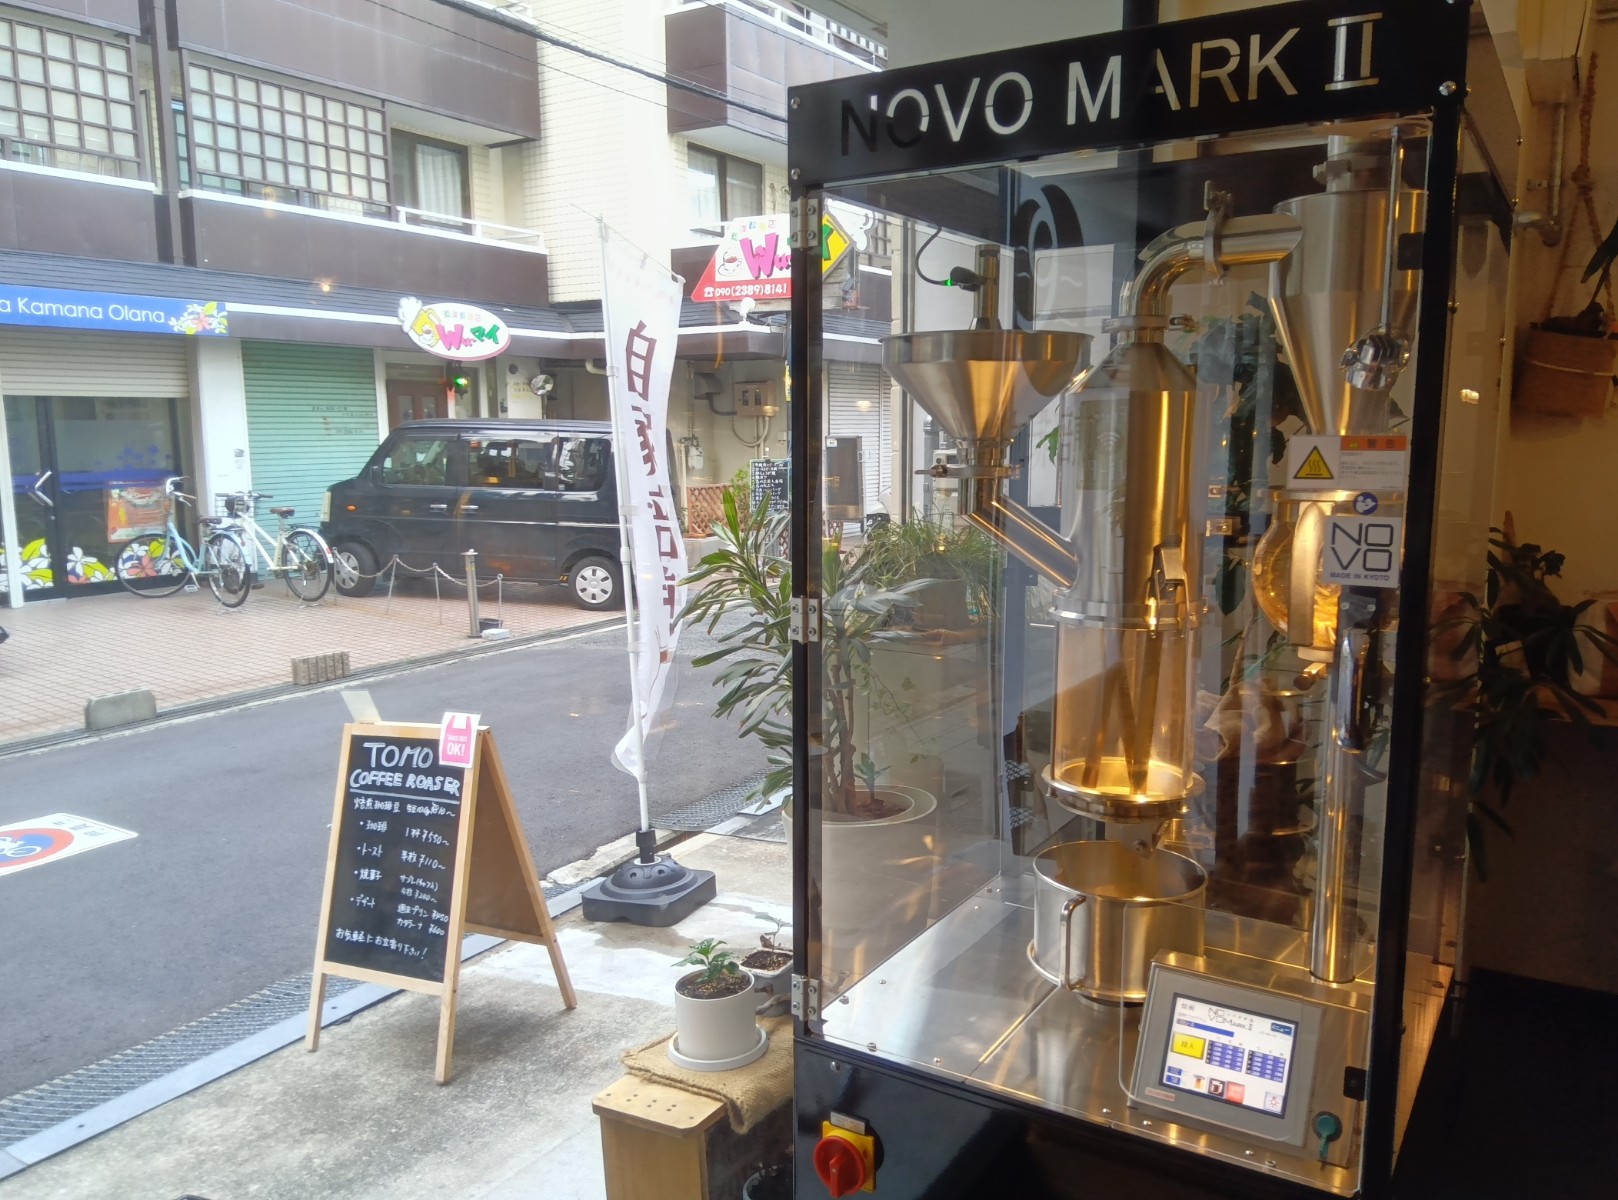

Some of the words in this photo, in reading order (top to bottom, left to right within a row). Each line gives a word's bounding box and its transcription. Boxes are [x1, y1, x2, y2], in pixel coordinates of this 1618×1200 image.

[840, 71, 1034, 157] NOVO
[1067, 26, 1301, 126] MARK
[17, 297, 103, 320] Kamana
[108, 304, 165, 323] Olana
[363, 742, 434, 768] TOMO
[447, 742, 465, 756] OK!
[349, 769, 403, 788] COFFEE
